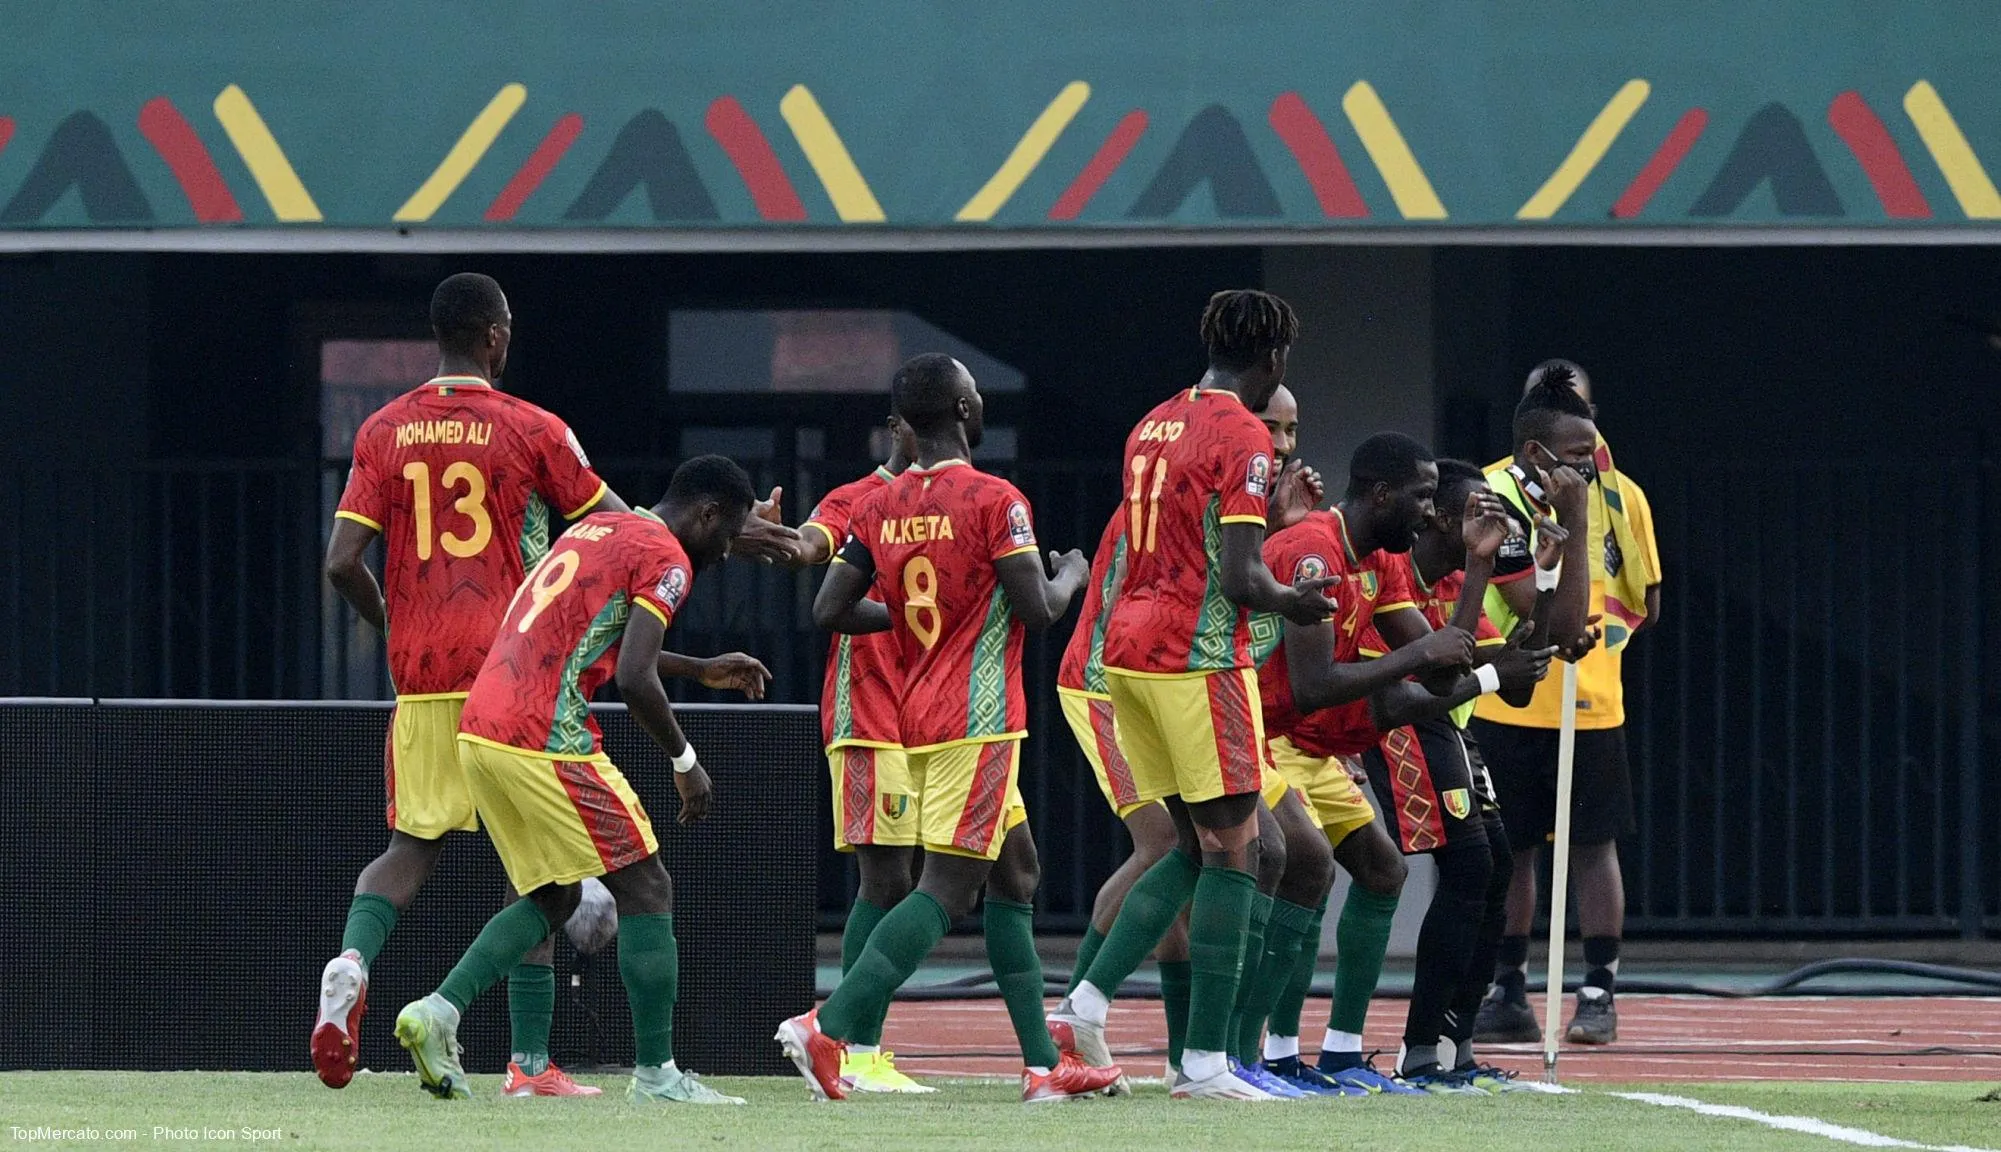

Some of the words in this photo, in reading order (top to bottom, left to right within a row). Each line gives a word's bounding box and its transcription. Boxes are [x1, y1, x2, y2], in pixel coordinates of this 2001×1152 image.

[396, 420, 464, 449] MOHAMED
[466, 421, 492, 446] ALI
[1139, 420, 1185, 443] BAYO
[402, 461, 493, 561] 13
[1130, 454, 1168, 554] 11
[903, 555, 942, 650] 8
[1341, 602, 1359, 638] 4
